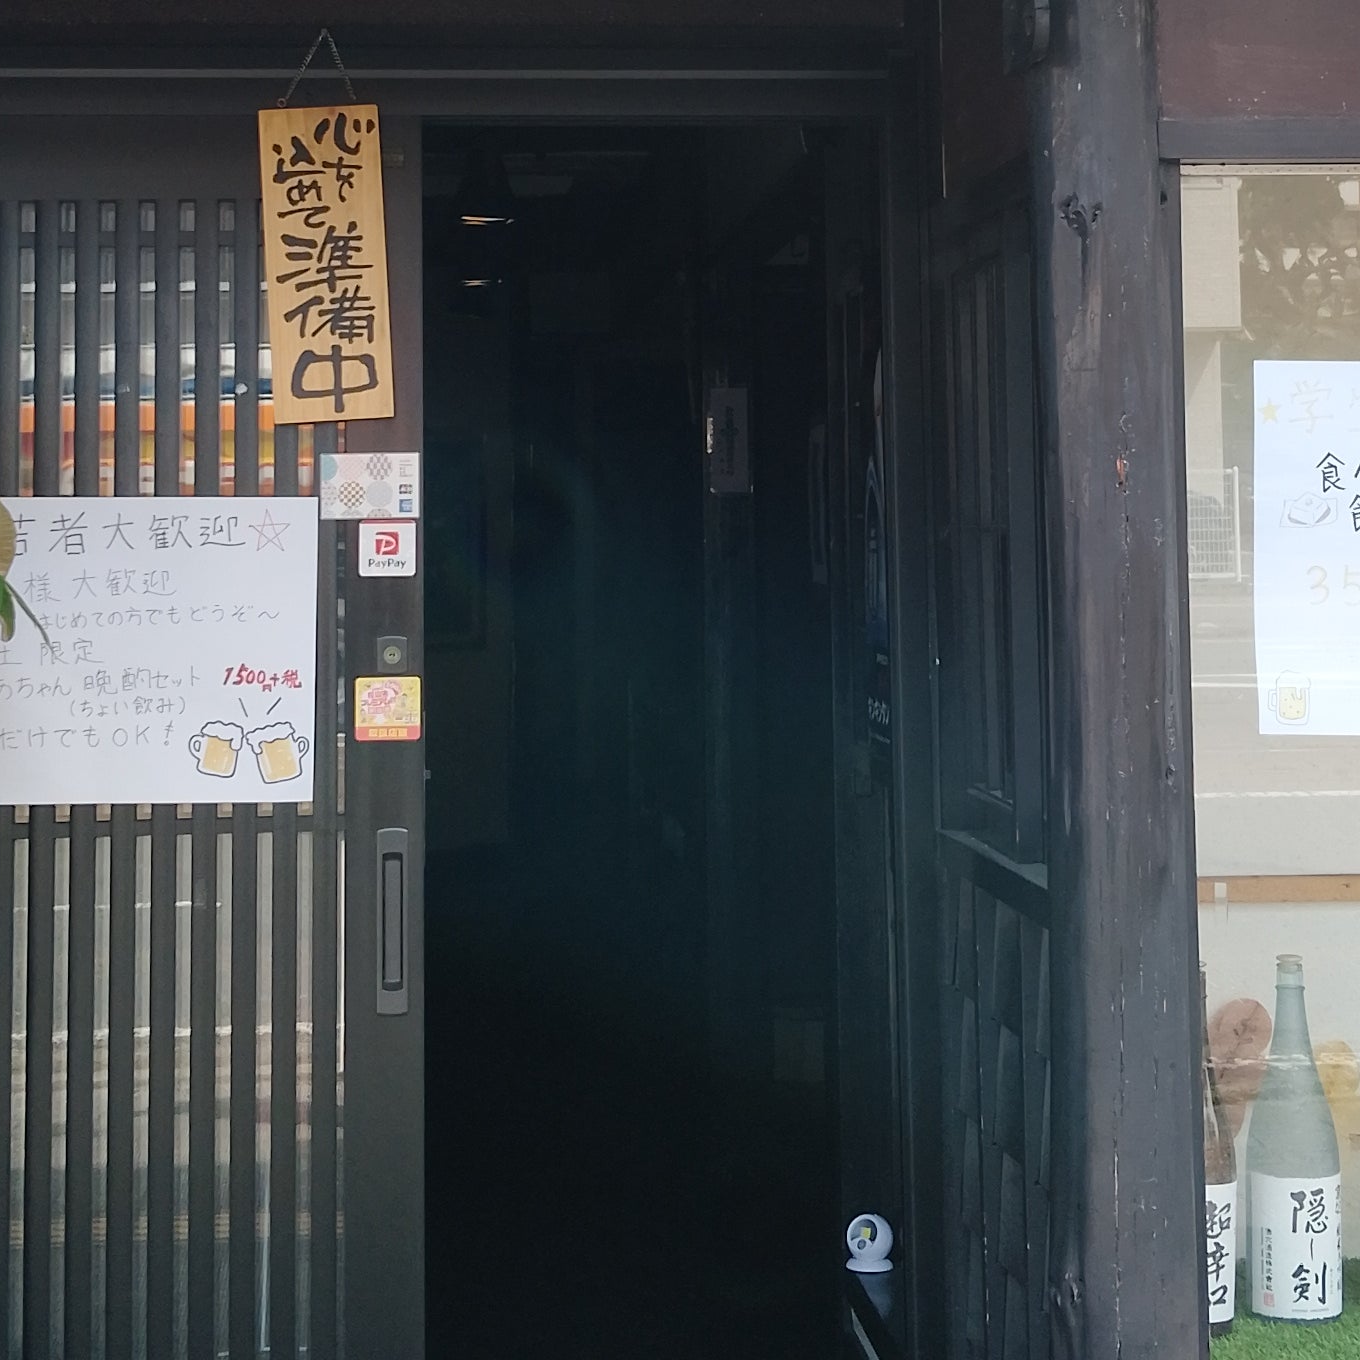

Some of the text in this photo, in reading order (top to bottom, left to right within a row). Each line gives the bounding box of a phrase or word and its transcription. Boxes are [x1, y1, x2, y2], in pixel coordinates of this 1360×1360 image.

[275, 220, 380, 414] 準備中
[368, 558, 407, 569] PayPay
[1290, 1187, 1330, 1305] 隠し剣
